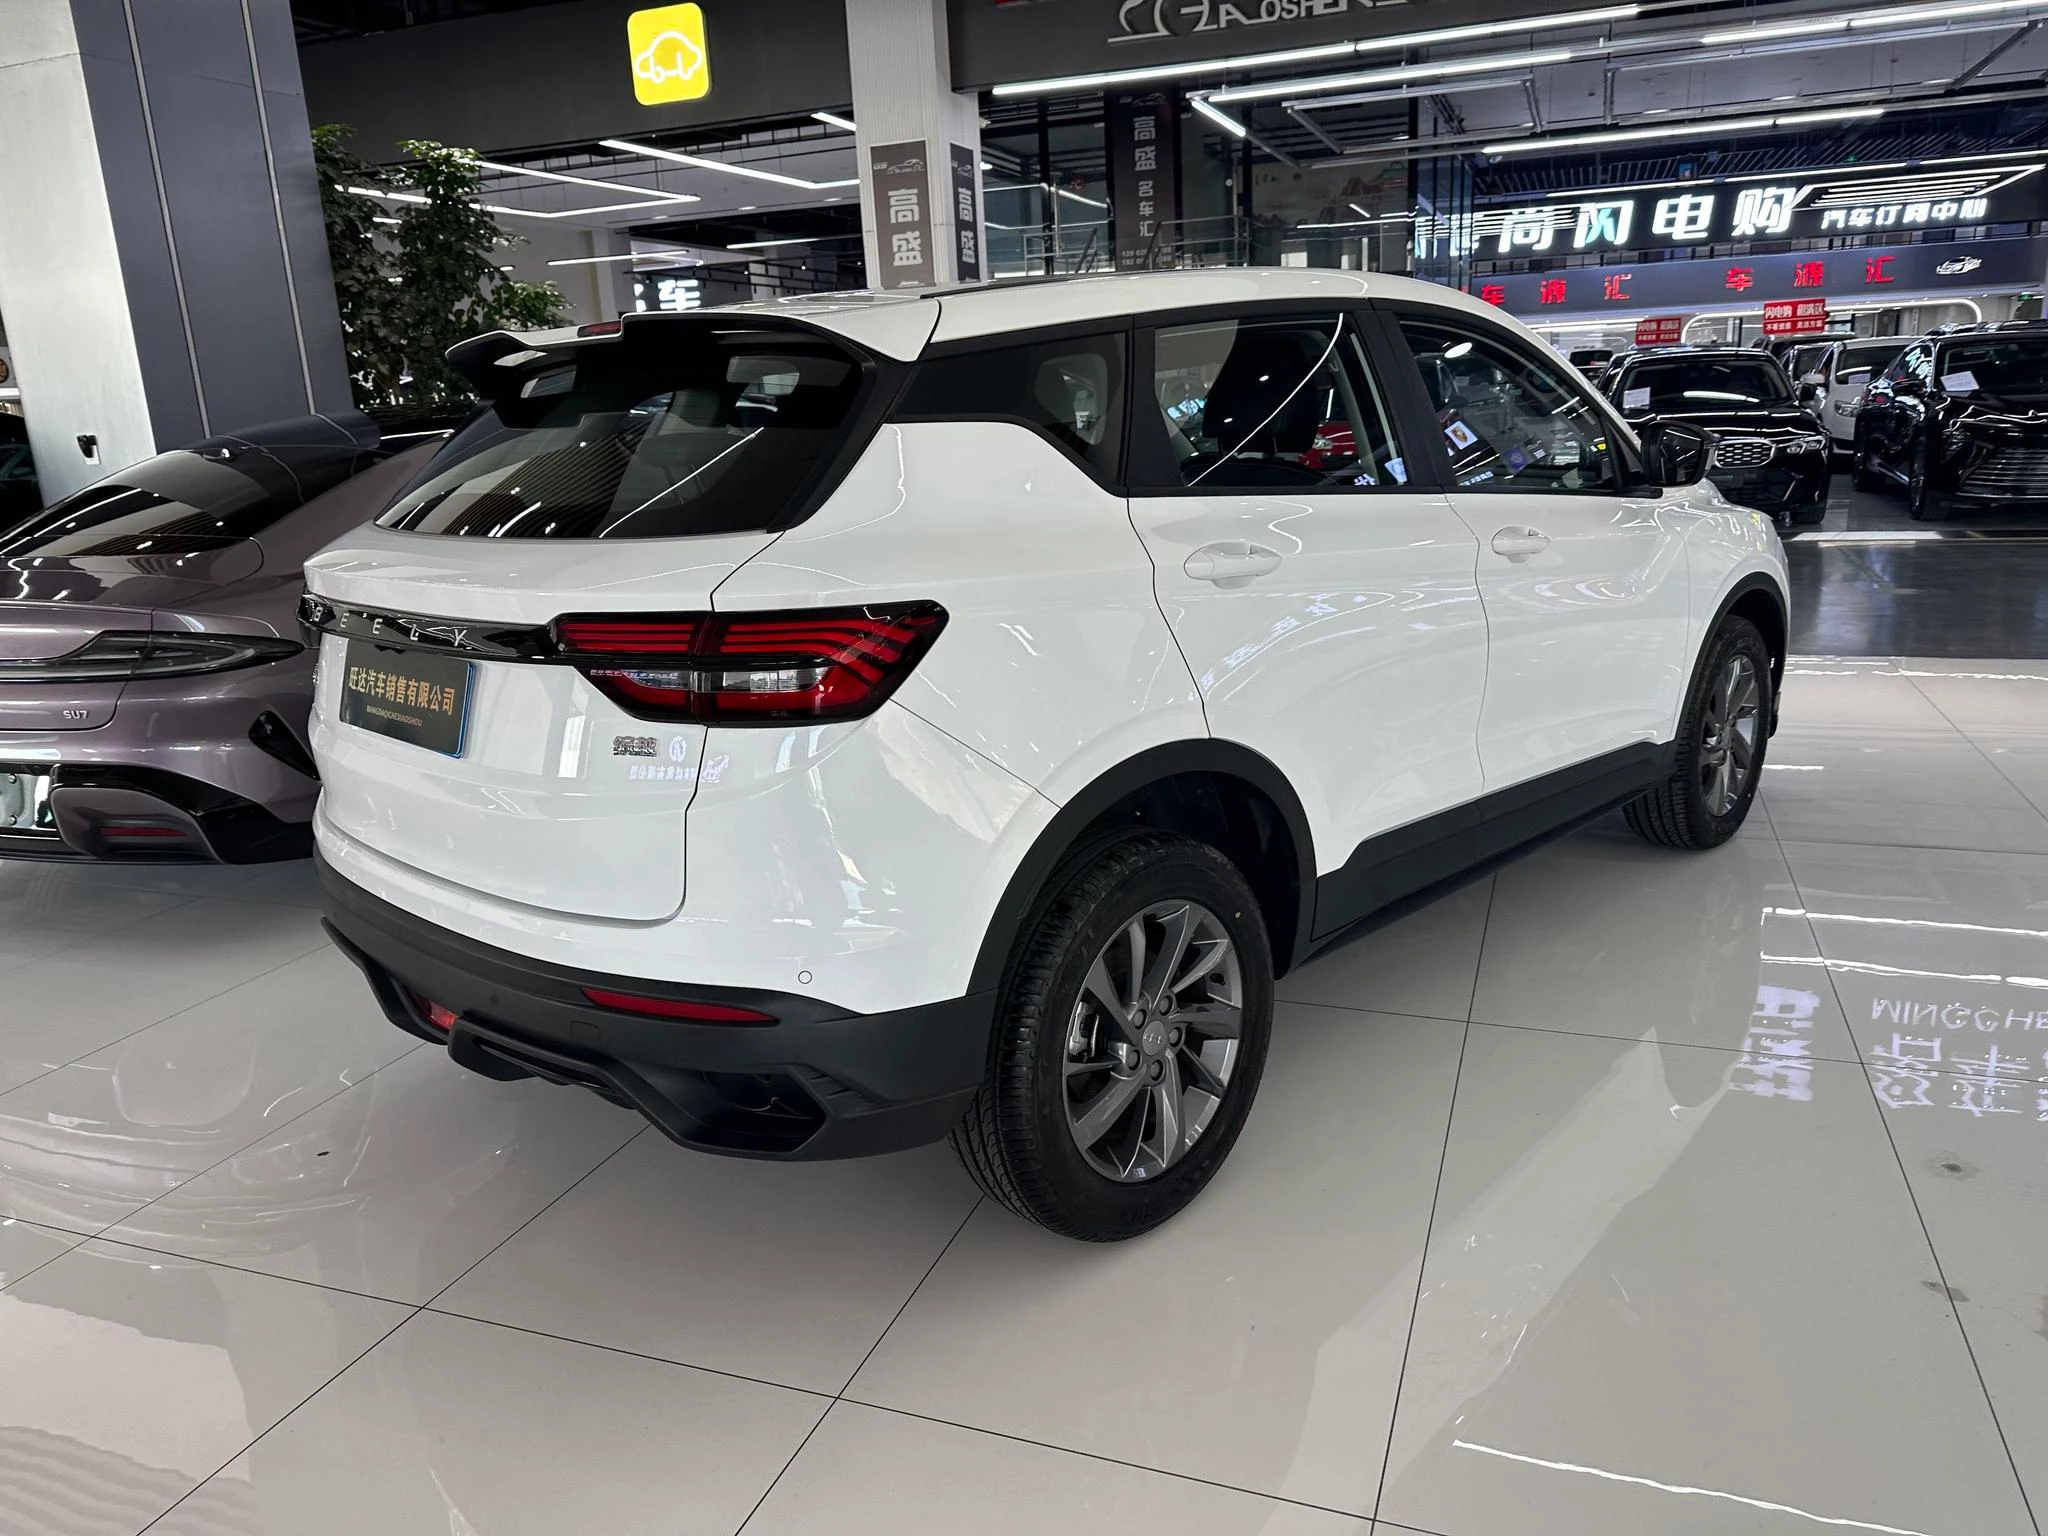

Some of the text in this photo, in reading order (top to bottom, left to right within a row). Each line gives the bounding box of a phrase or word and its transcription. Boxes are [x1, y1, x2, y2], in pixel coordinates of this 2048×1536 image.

[887, 188, 925, 288] 高盛
[957, 187, 976, 282] 高盛
[1481, 273, 1633, 306] 车源汇
[1725, 255, 1896, 293] 车源汇
[349, 666, 455, 715] 旺达汽车销售有限公司
[63, 710, 88, 719] SU7
